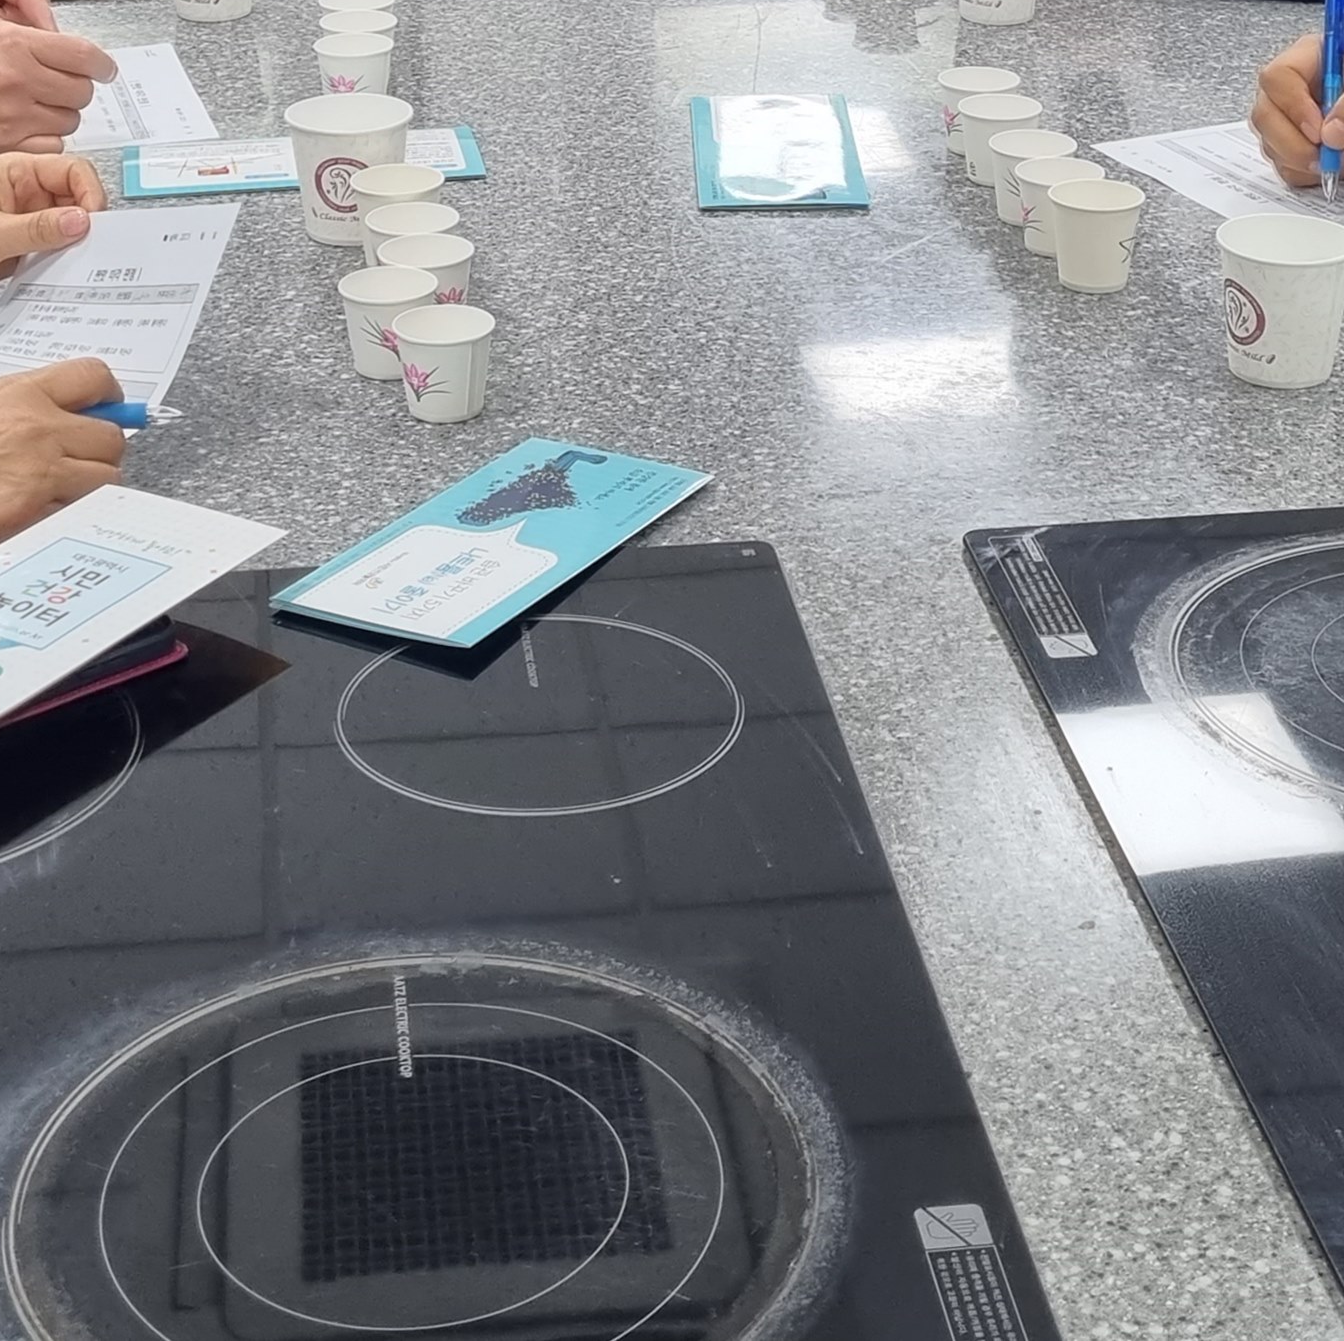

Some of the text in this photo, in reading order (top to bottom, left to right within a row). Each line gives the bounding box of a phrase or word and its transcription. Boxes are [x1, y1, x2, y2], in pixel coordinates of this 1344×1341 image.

[50, 564, 110, 587] 시민
[72, 553, 131, 573] 대구광역시
[26, 579, 80, 605] 건강
[371, 580, 430, 615] 줄이기
[438, 571, 473, 604] 바꾸기
[399, 594, 442, 621] 5가지
[394, 997, 410, 1035] ELECTRIC
[397, 1036, 413, 1079] COOKTOP
